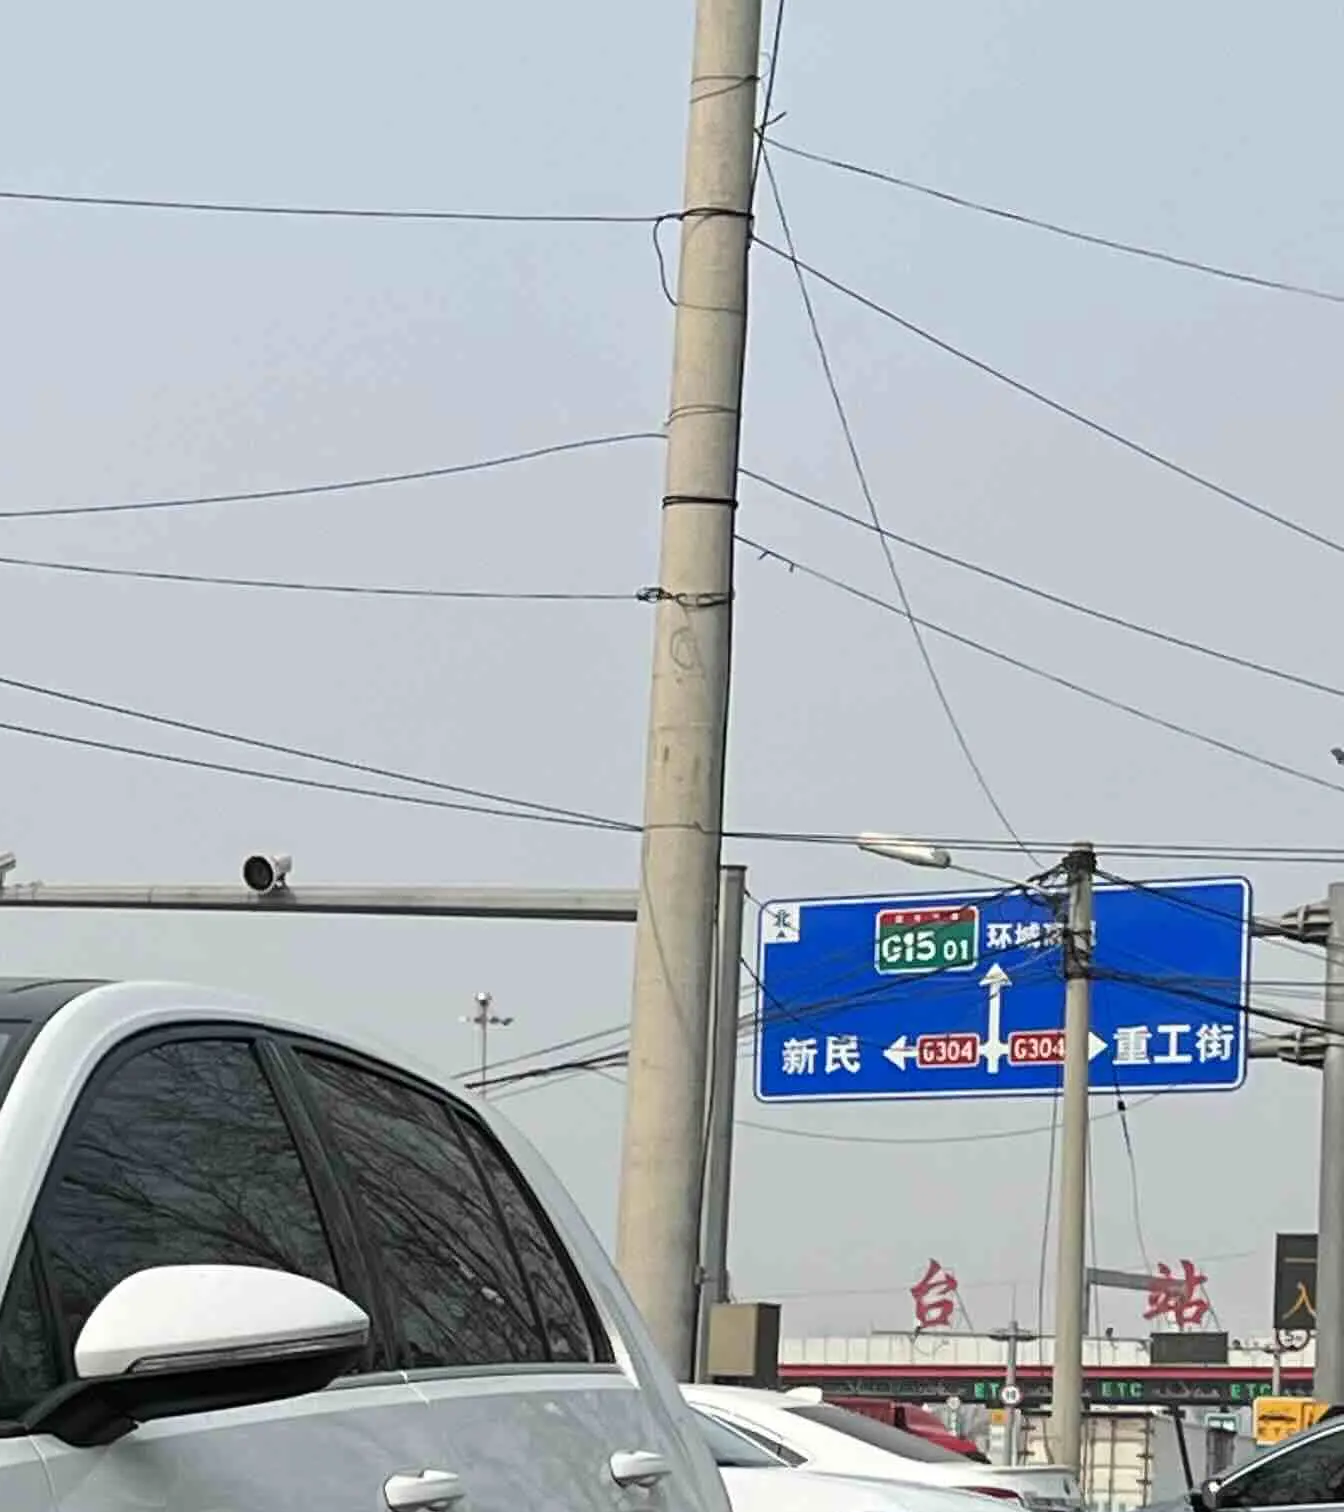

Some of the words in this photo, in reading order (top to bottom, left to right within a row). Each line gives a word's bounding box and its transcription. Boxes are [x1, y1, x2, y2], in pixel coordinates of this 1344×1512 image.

[985, 920, 1097, 950] 环城
[781, 1035, 862, 1075] 新民
[922, 1038, 974, 1063] G304
[1013, 1036, 1065, 1060] G304
[1112, 1022, 1235, 1065] 重工街
[910, 1257, 959, 1329] 台
[1142, 1258, 1209, 1328] 站
[1100, 1381, 1145, 1398] ETC
[1230, 1382, 1273, 1400] ETC
